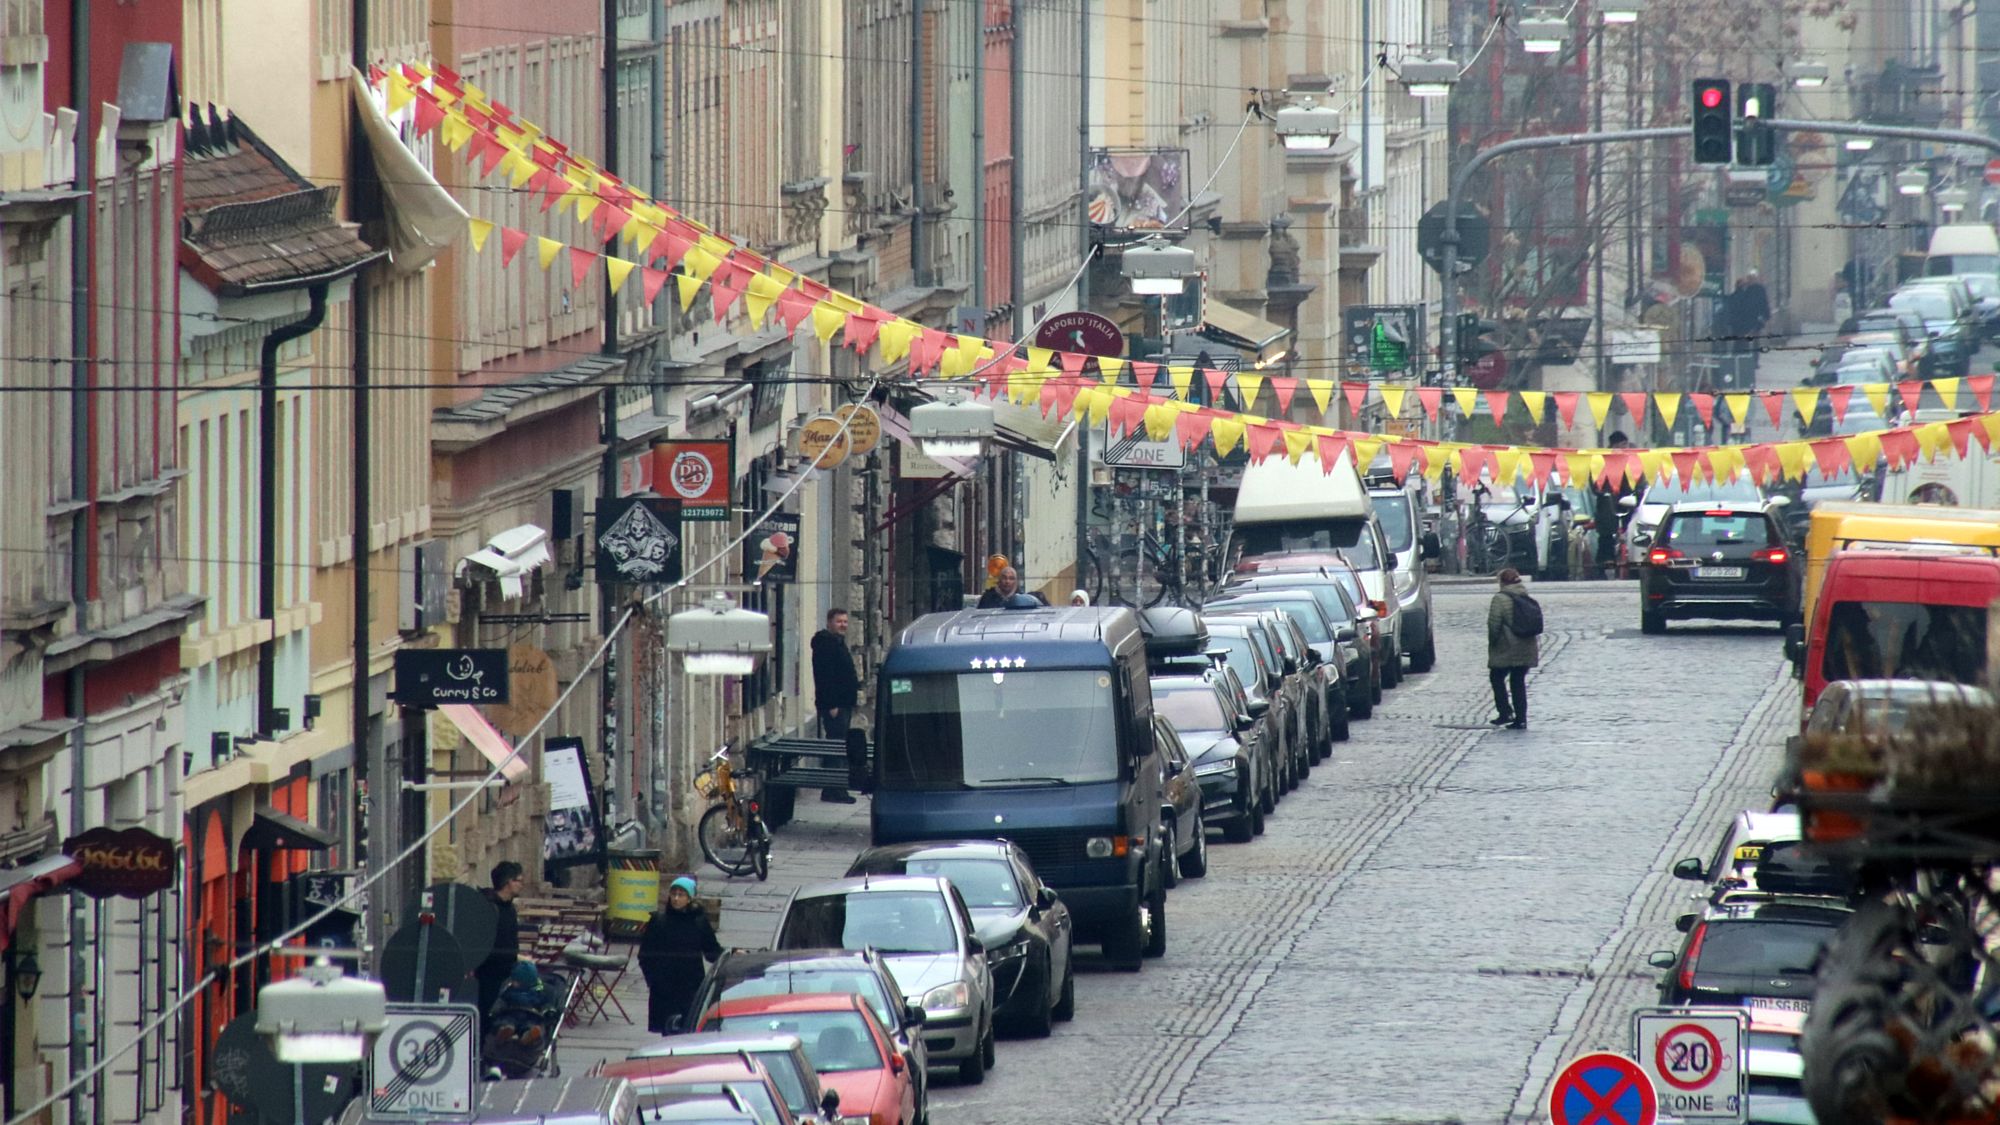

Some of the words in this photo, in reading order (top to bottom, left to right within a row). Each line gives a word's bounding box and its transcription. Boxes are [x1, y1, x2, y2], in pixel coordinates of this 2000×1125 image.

[1044, 317, 1077, 337] SAPORI
[1124, 448, 1165, 462] ZONE
[681, 508, 725, 517] 121719072
[432, 687, 469, 699] Curry
[482, 687, 498, 697] Co
[1741, 849, 1761, 859] TA
[402, 1038, 441, 1069] 30
[1671, 1042, 1709, 1073] 20
[397, 1091, 448, 1108] ZONE
[1674, 1094, 1714, 1112] ONE
